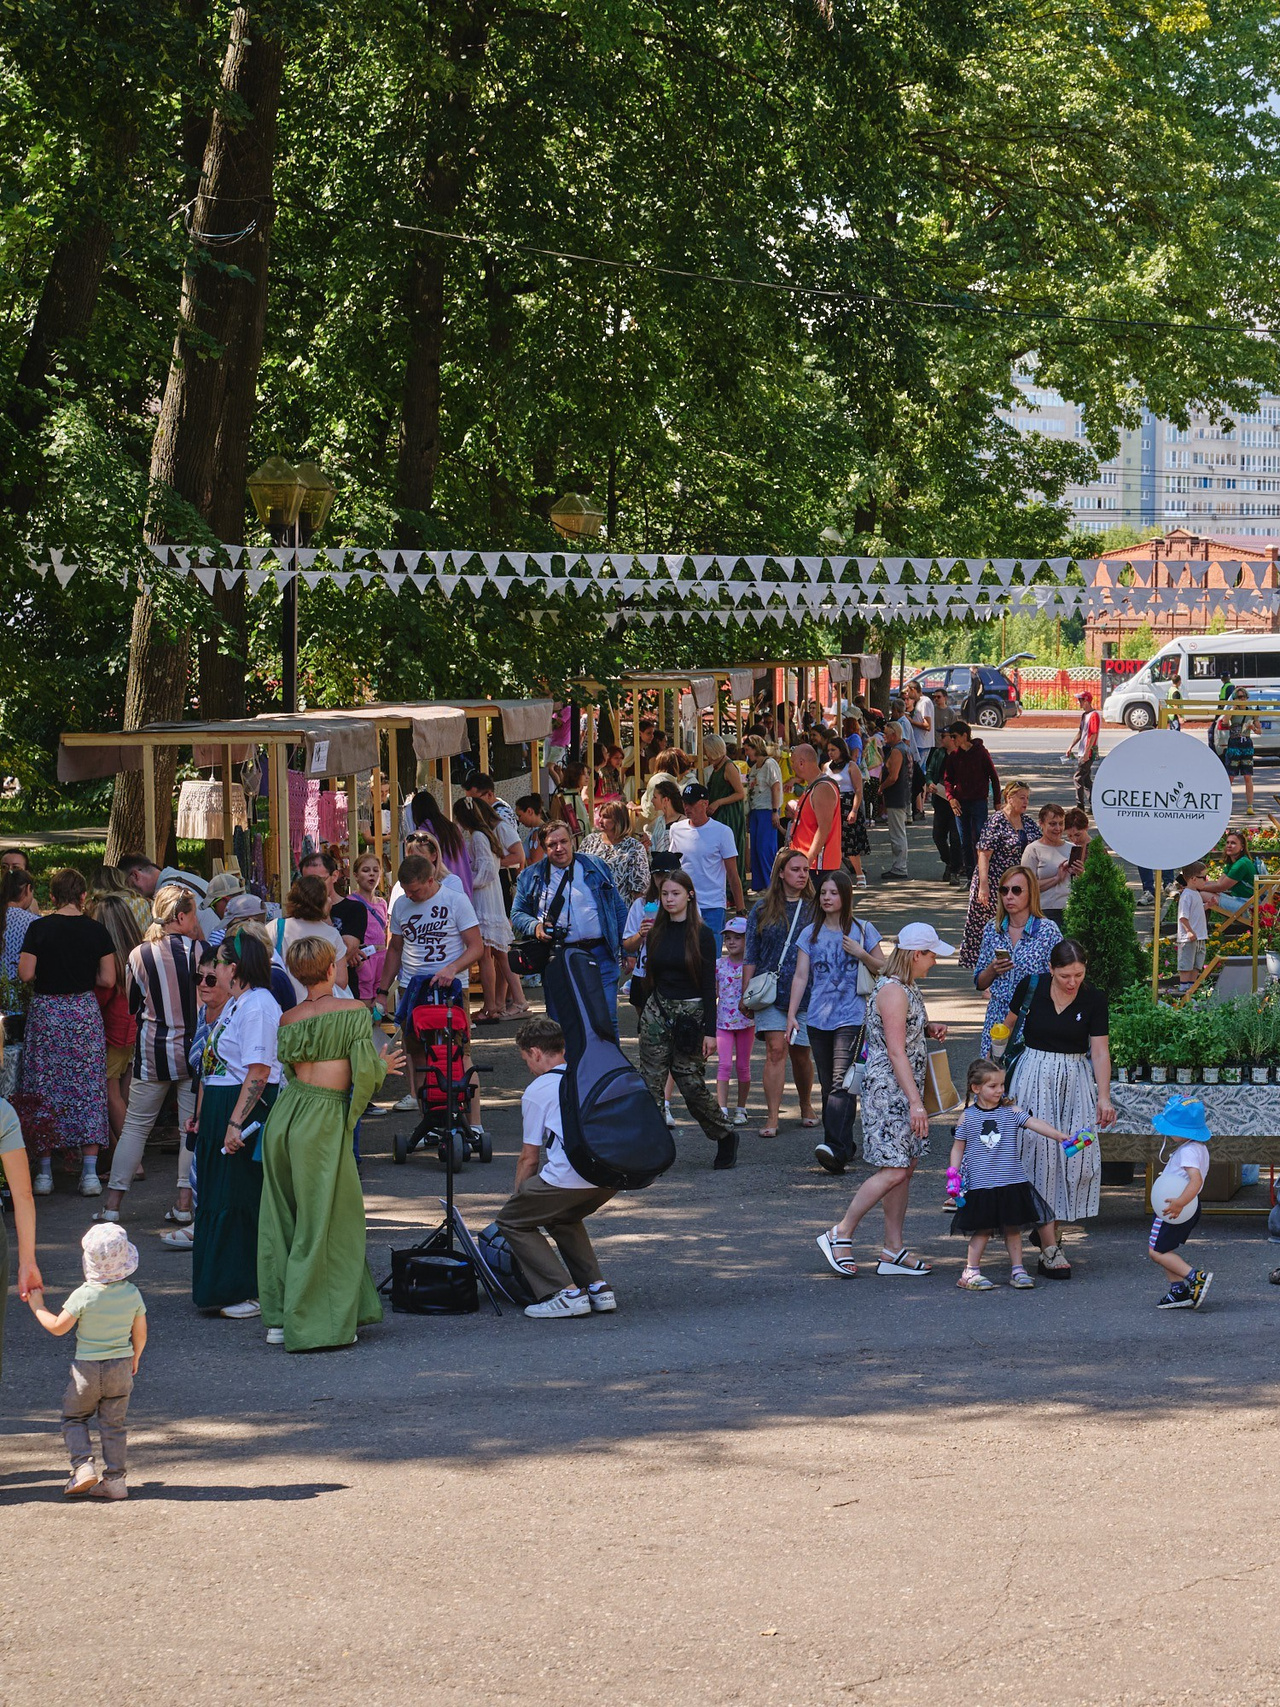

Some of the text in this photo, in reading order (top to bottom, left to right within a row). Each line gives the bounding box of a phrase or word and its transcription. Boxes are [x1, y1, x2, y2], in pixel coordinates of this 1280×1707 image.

[1101, 789, 1223, 810] GREEN ART
[1117, 810, 1205, 820] ГРУППА КОМПАНИЙ
[401, 914, 448, 942] Super
[424, 945, 447, 962] 23
